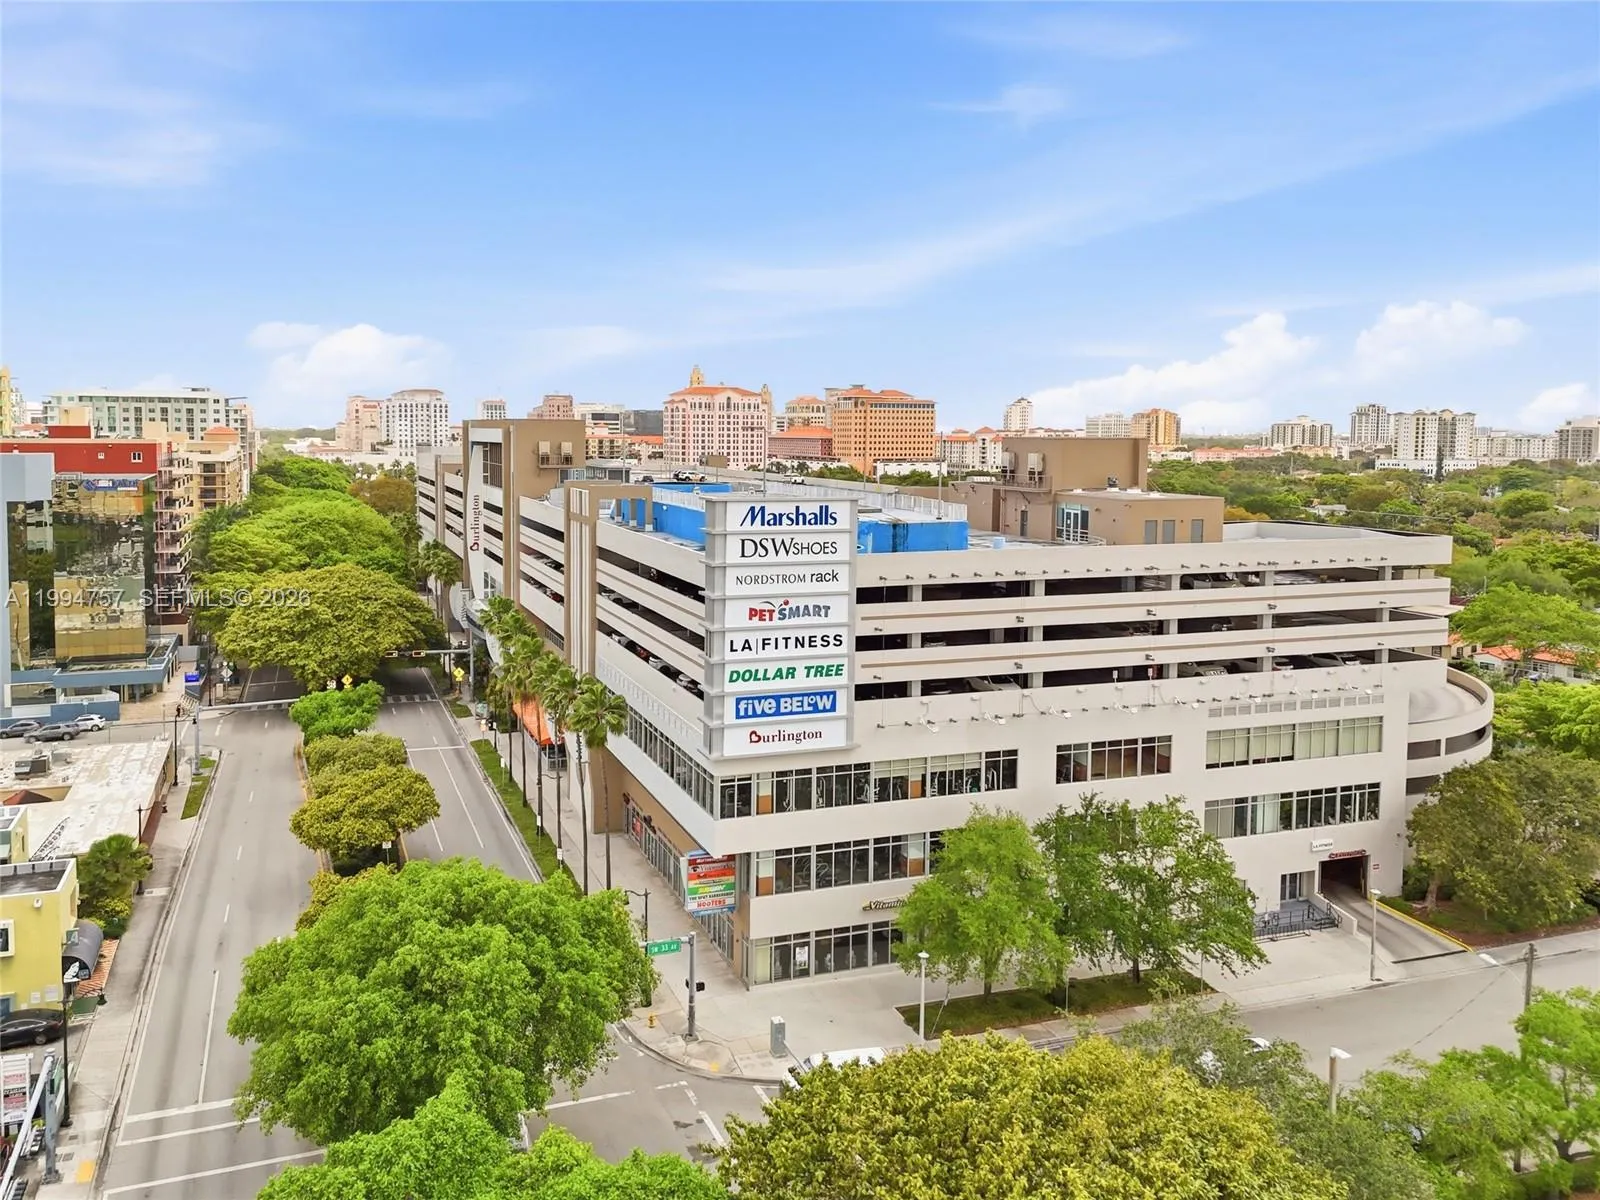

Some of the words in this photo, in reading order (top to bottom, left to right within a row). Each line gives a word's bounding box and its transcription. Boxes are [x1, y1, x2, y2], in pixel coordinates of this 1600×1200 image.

[470, 494, 482, 551] Burlington
[740, 505, 838, 527] Marshalls
[736, 573, 806, 586] NORDSTROM
[810, 569, 839, 583] rack
[728, 666, 796, 683] DOLLAR
[804, 664, 844, 678] TREE
[780, 694, 834, 713] BELOW
[749, 729, 822, 745] Burlington
[697, 899, 726, 908] HOOTERS
[662, 943, 669, 951] 33
